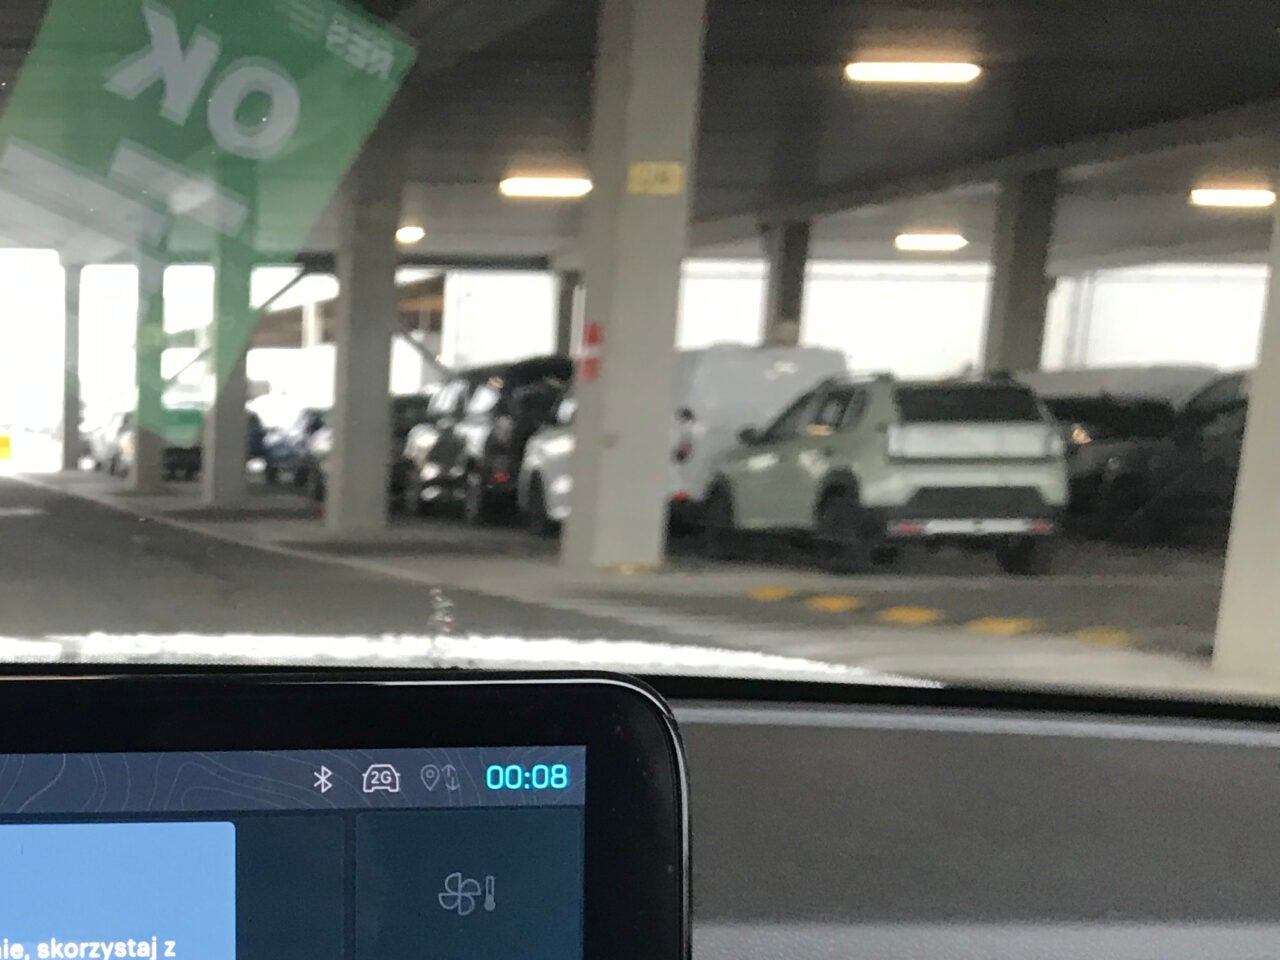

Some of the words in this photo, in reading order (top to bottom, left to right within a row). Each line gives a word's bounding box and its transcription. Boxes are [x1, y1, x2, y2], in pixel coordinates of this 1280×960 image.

[370, 770, 392, 785] 2G
[486, 764, 568, 790] 00:08
[163, 940, 177, 957] z
